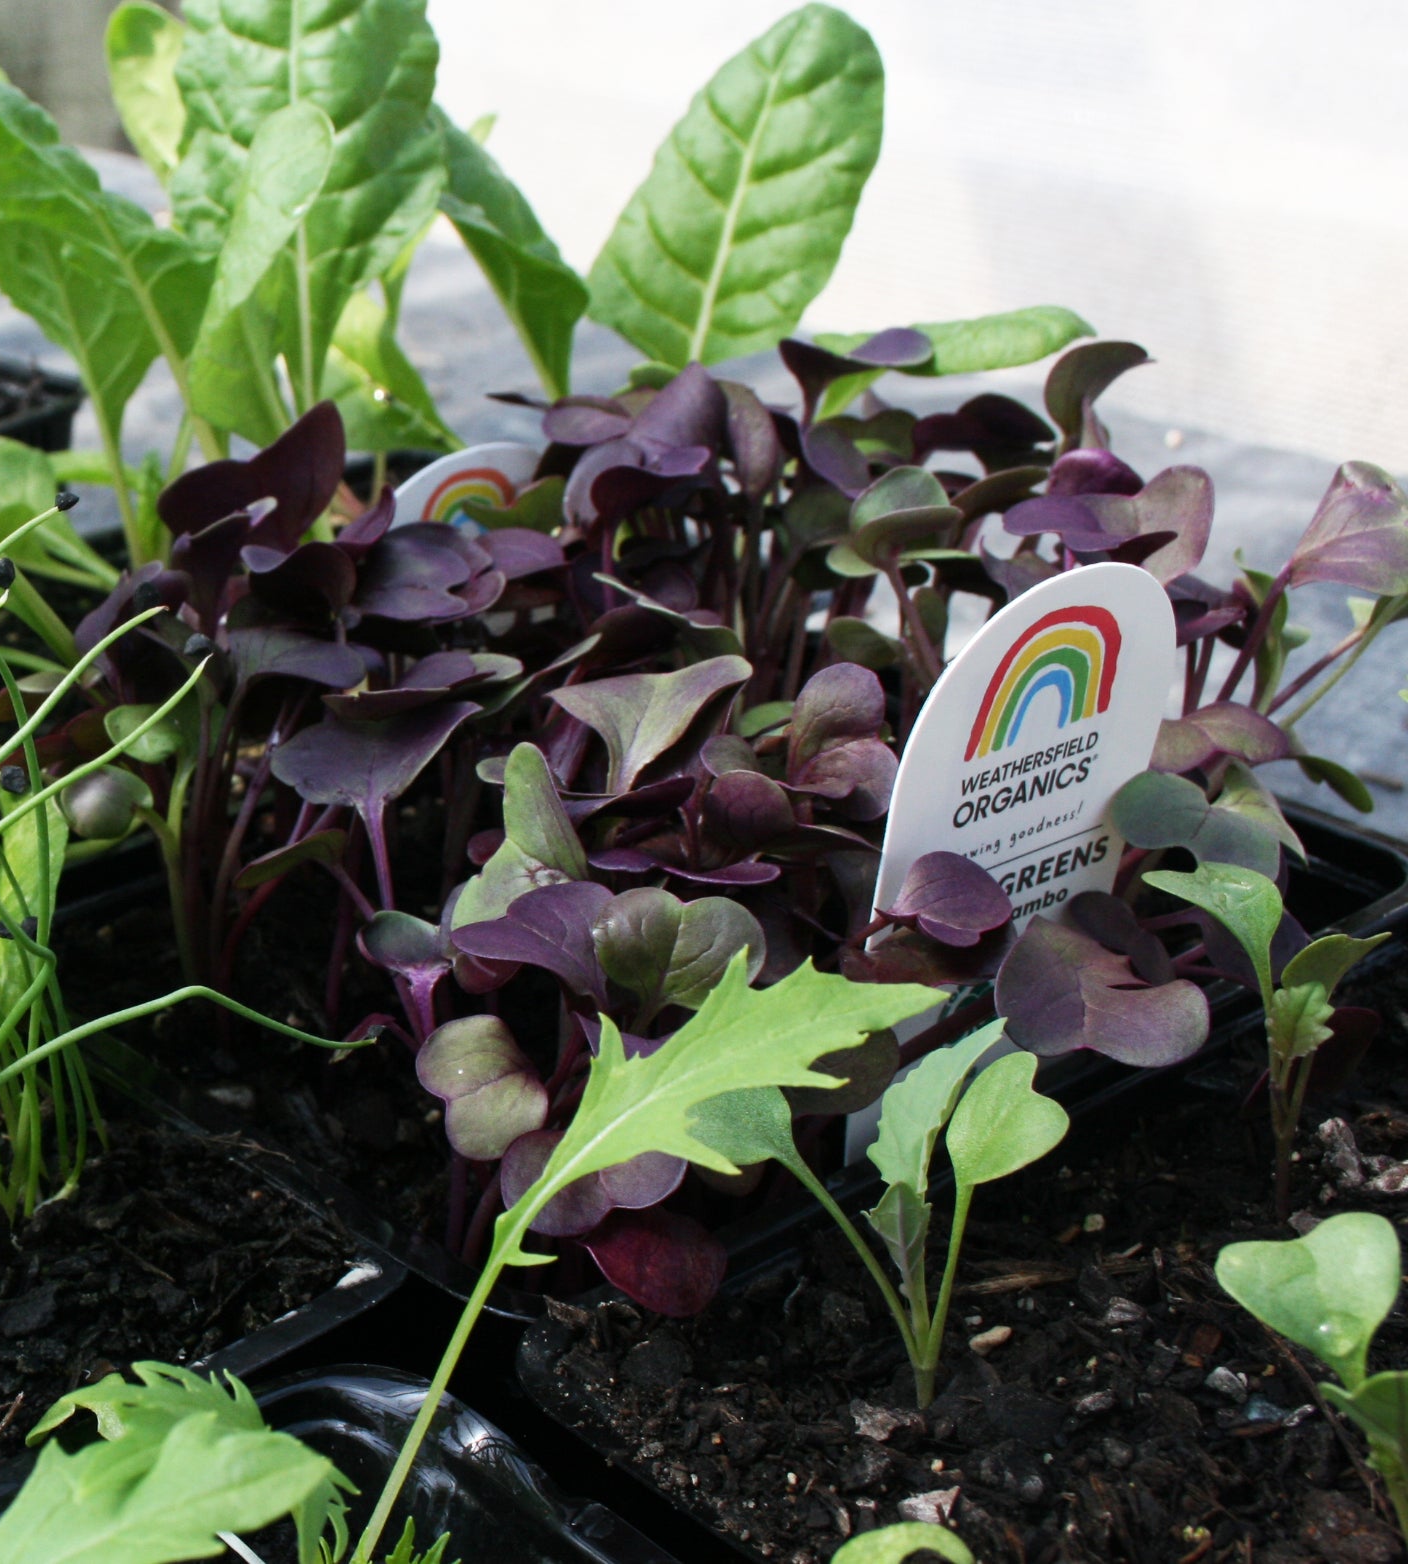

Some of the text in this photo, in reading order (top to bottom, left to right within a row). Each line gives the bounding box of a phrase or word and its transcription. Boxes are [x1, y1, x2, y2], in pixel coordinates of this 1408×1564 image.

[953, 756, 1092, 829] ORGANICS
[961, 731, 1099, 797] WEATHERSFIELD
[963, 800, 1084, 859] wing goodness!
[1011, 887, 1069, 921] ambo
